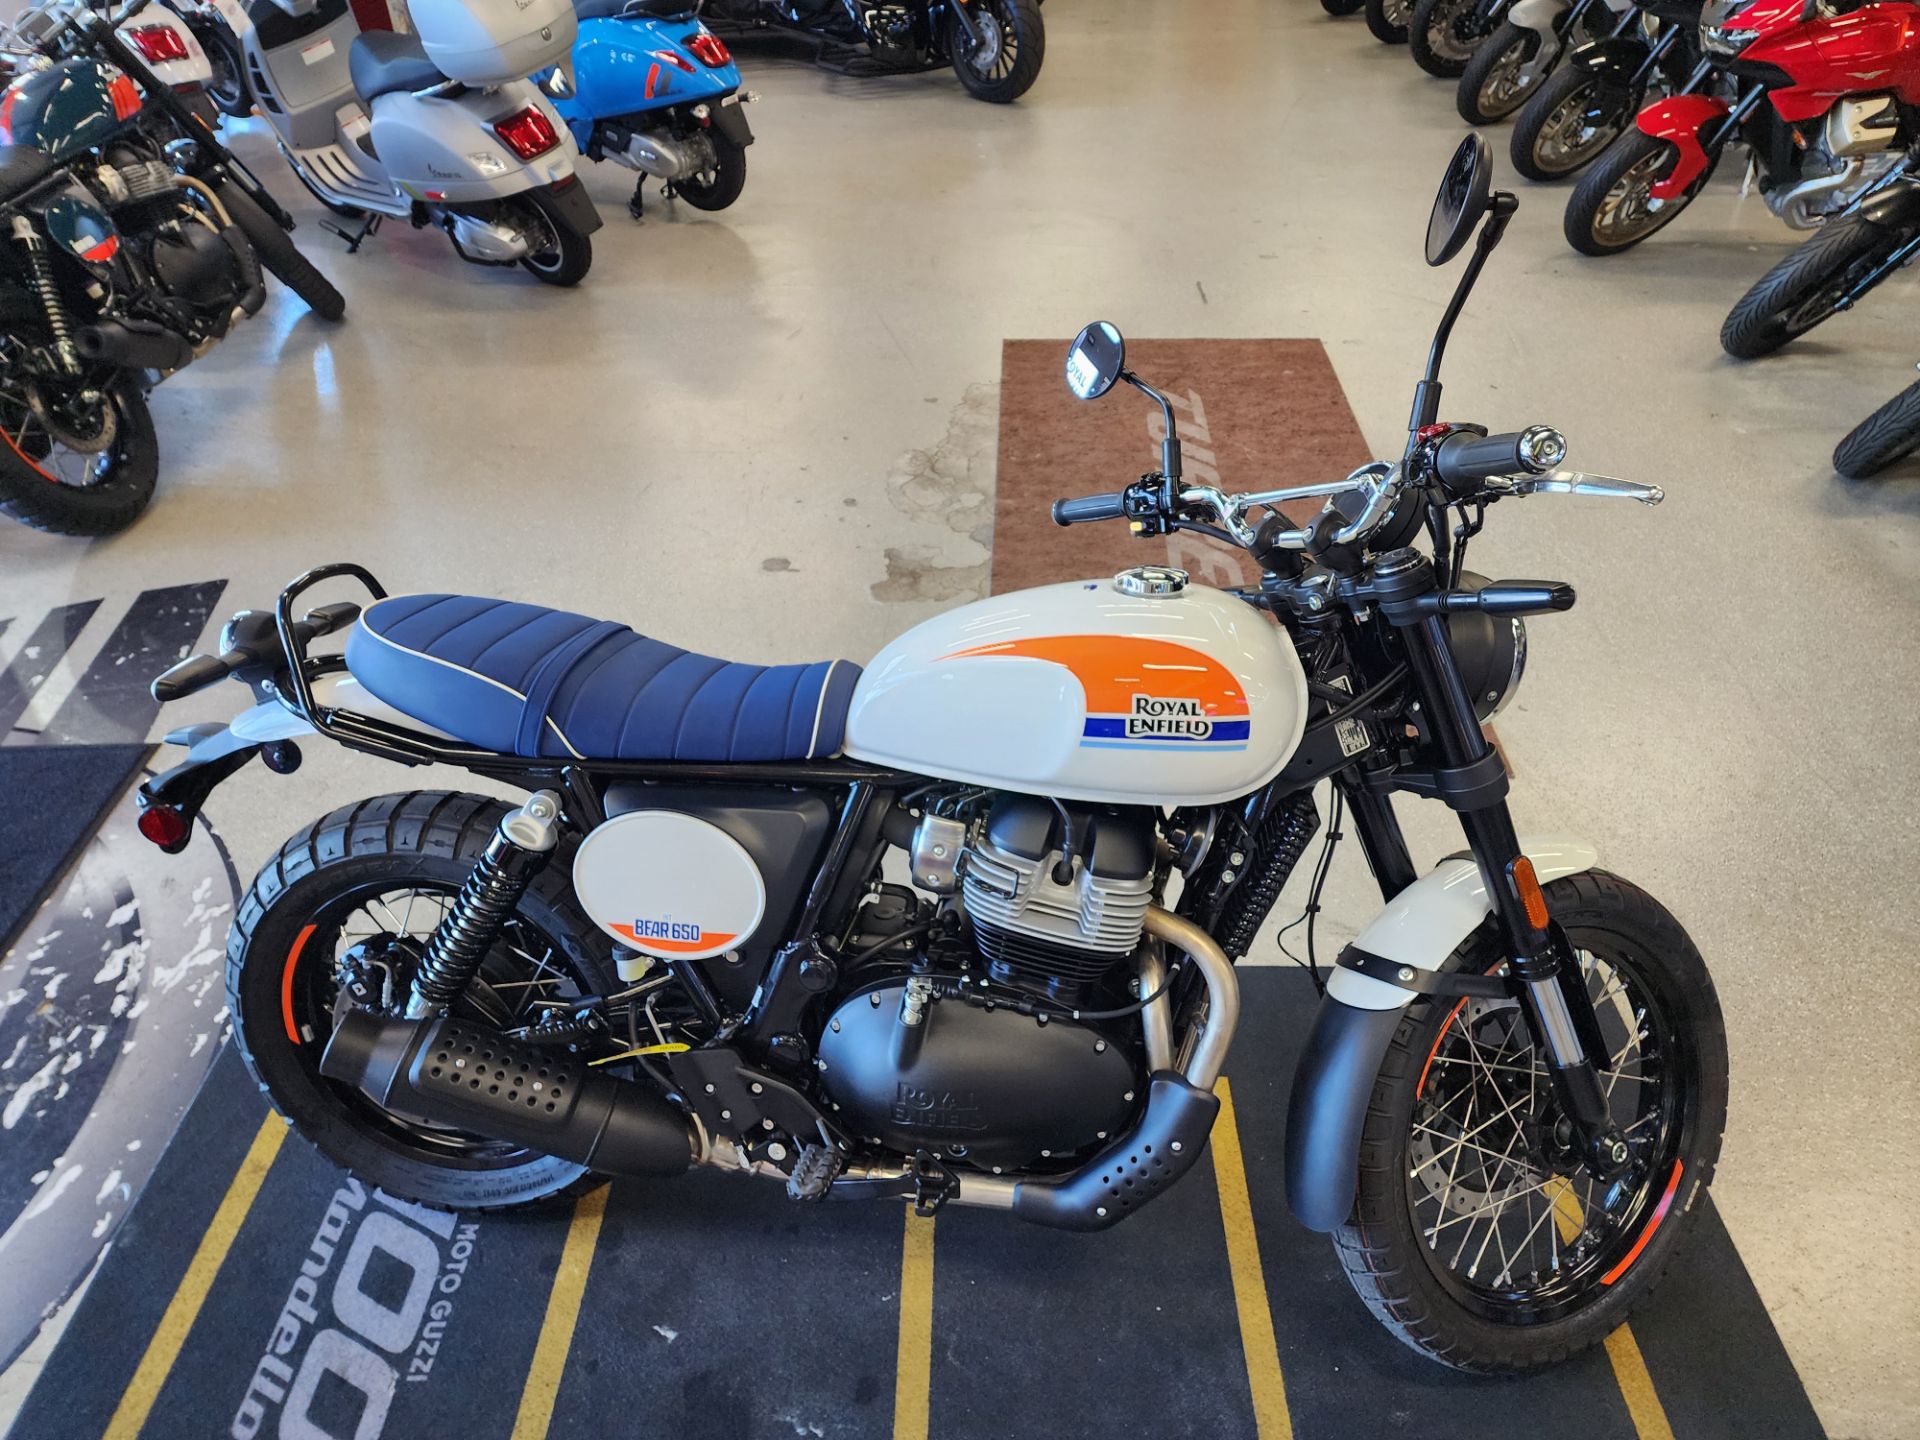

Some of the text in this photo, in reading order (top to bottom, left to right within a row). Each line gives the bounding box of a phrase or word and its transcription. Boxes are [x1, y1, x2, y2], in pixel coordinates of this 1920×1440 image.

[1135, 697, 1202, 717] ROYAL
[1128, 718, 1210, 737] ENFIELD
[635, 919, 700, 941] BEAR 650
[405, 1223, 480, 1382] MOTO GUZZI
